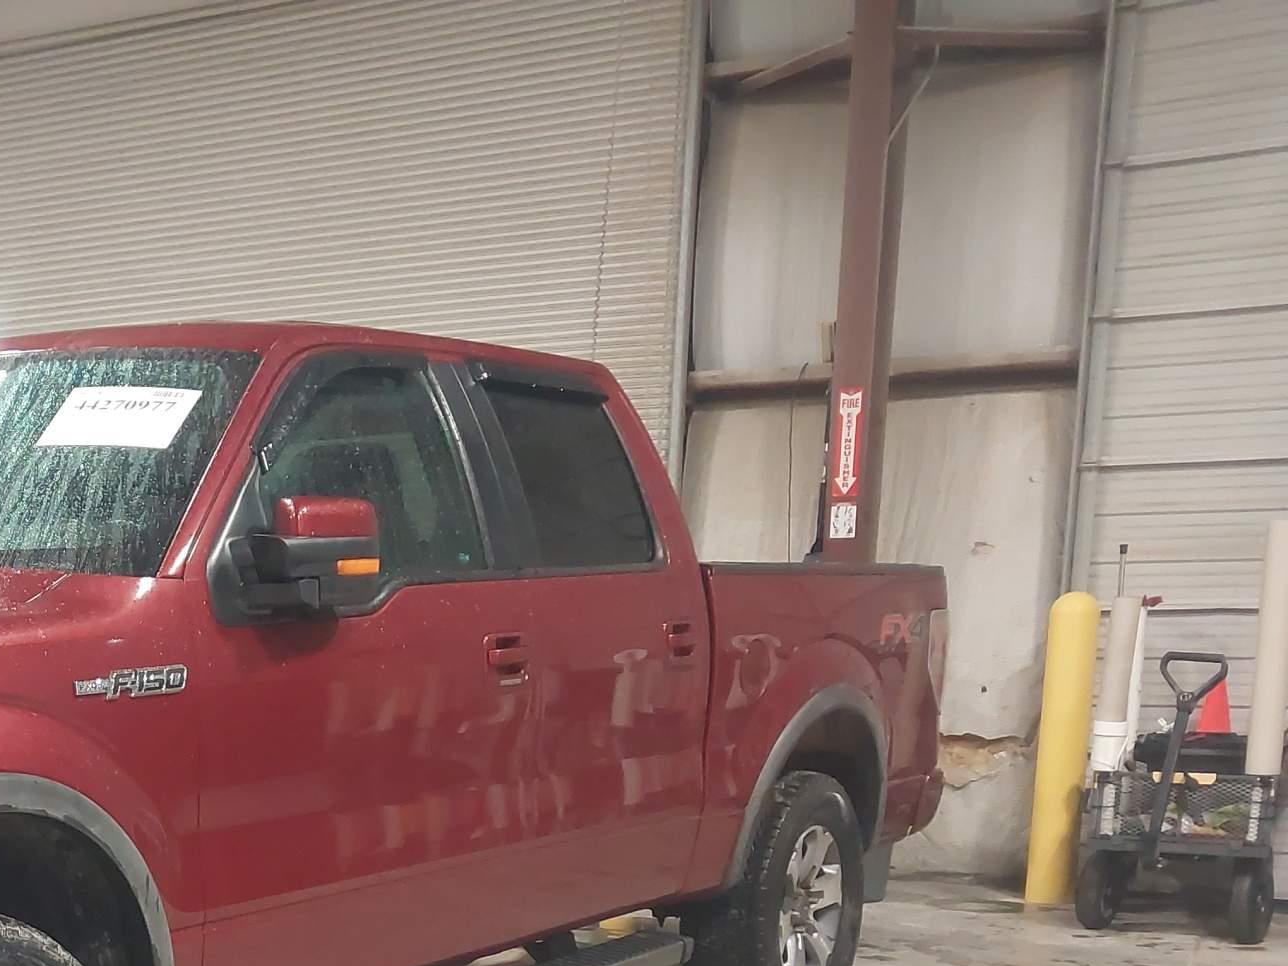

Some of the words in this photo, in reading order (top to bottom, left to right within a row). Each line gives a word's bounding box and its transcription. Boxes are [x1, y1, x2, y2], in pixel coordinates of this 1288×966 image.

[75, 399, 177, 413] 44270977
[842, 398, 860, 409] FIRE
[842, 412, 855, 489] EXTINGUISHER
[879, 613, 930, 646] FX4
